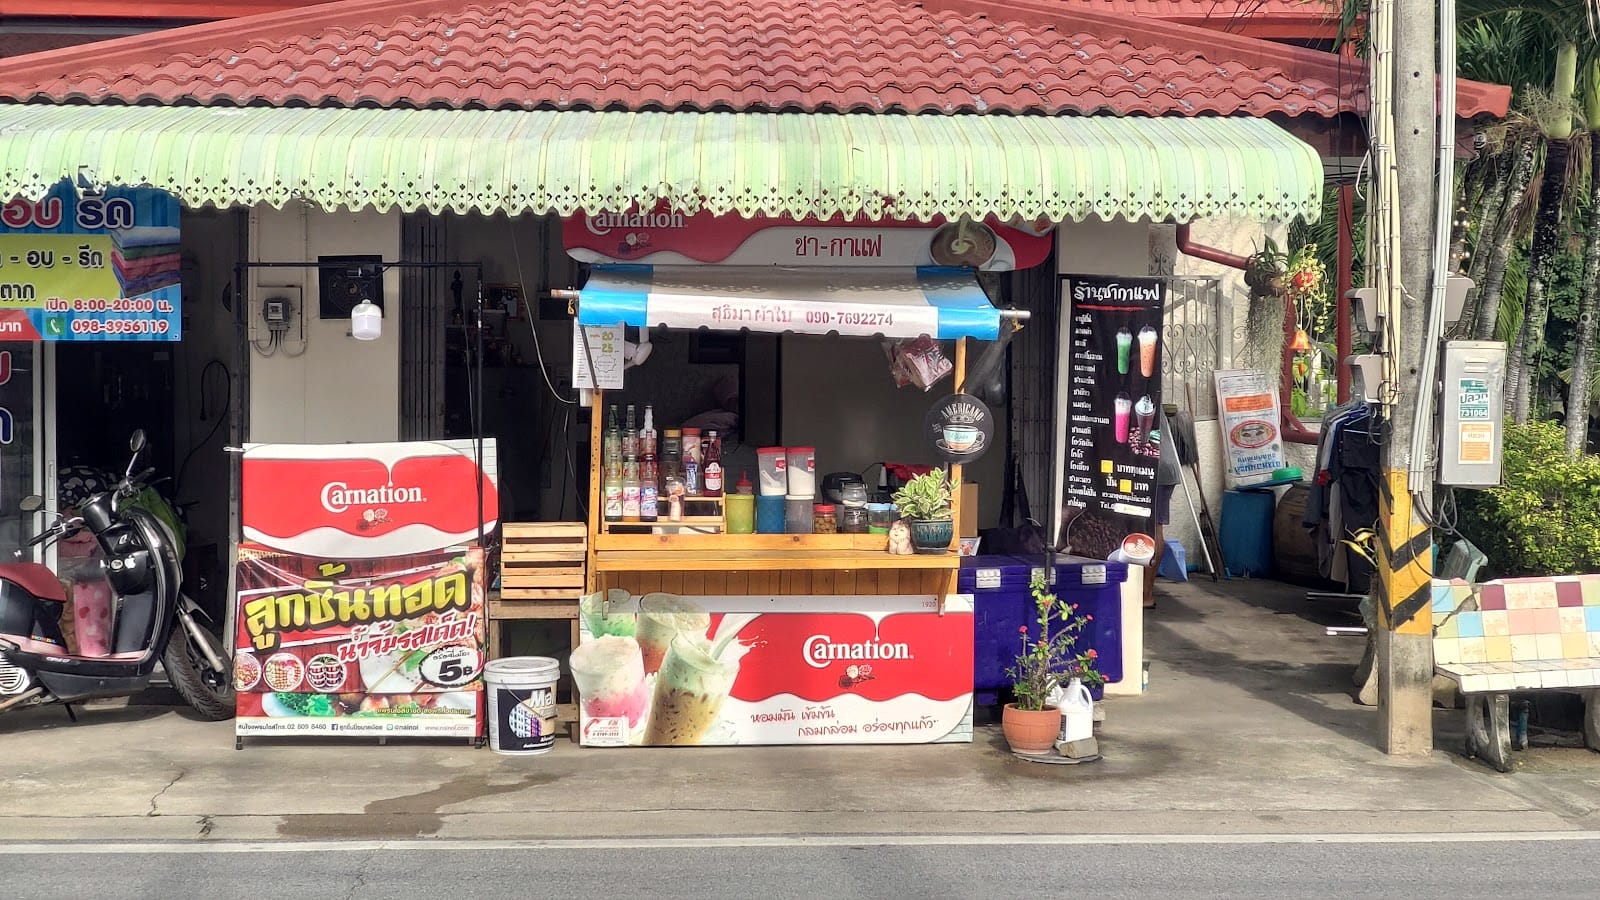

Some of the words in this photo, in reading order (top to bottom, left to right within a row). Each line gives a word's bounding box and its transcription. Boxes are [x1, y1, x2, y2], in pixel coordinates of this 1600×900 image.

[1, 196, 63, 229] อบ
[27, 250, 54, 268] อบ
[79, 245, 104, 269] รีด
[795, 233, 882, 258] ชา-กาแฟ
[1073, 280, 1160, 302] ร้านชากาแฟ
[46, 297, 69, 312] เปิด
[74, 299, 153, 313] 8:00-20:00
[157, 300, 174, 313] น.
[71, 319, 170, 335] 098-3956119
[806, 310, 894, 327] 090-7692274
[940, 402, 985, 421] AMERICANO
[320, 481, 424, 513] Carnation
[244, 563, 467, 651] ลูกชิ้นทอด
[337, 611, 477, 662] น้ำจิ้มรสเด็ด!
[802, 634, 910, 669] Carnation
[750, 708, 796, 723] หอมมัน
[801, 705, 836, 721] เข้มข้น
[798, 721, 858, 737] กลมกล่อม
